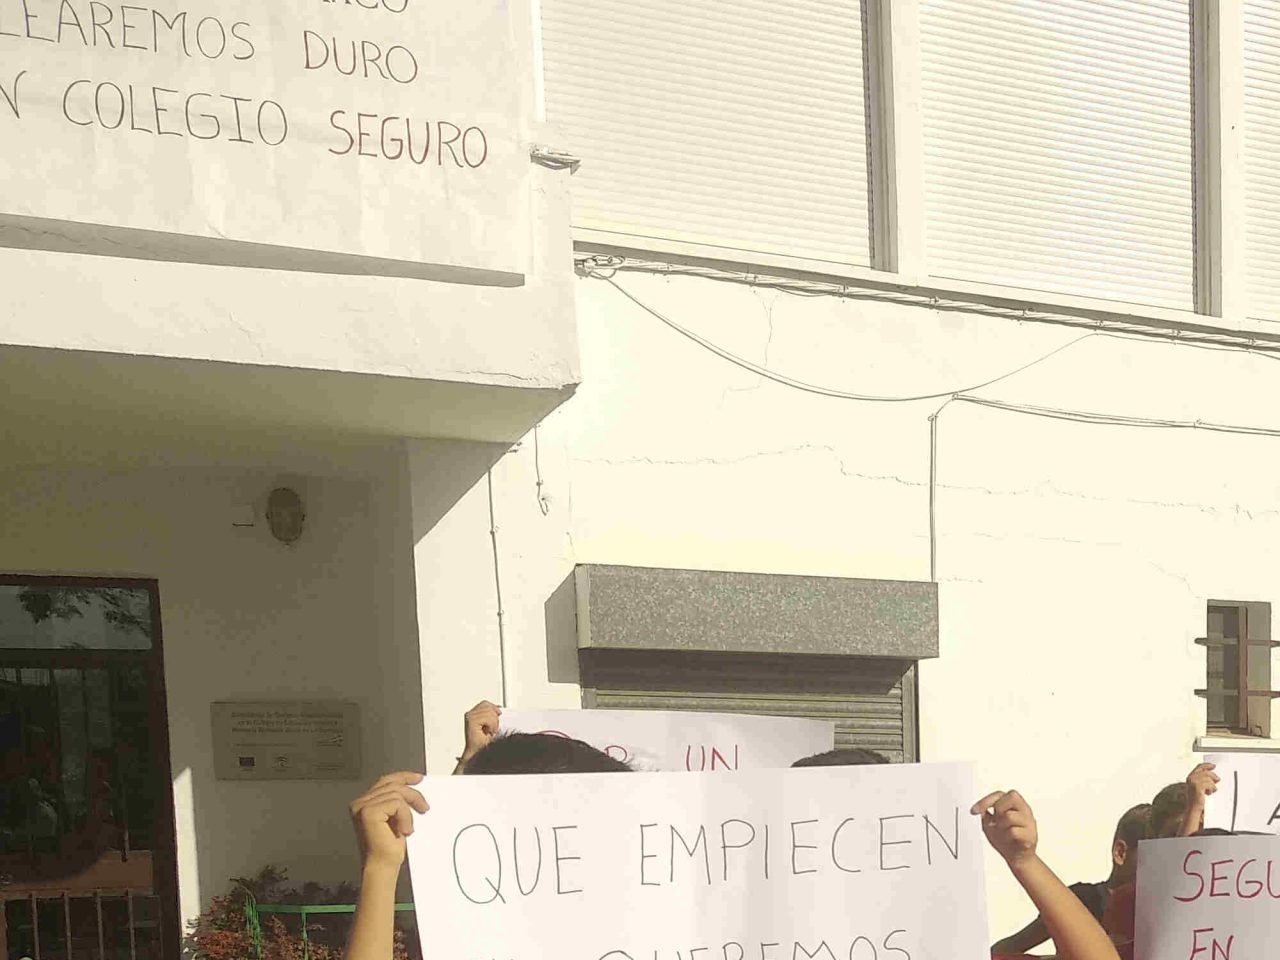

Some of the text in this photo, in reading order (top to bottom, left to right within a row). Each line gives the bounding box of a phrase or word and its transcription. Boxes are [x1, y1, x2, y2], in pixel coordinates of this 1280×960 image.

[303, 30, 419, 83] DURO
[62, 78, 288, 146] COLEGIO
[328, 110, 488, 168] SEGURO
[452, 807, 961, 905] QUE EMPIECEN
